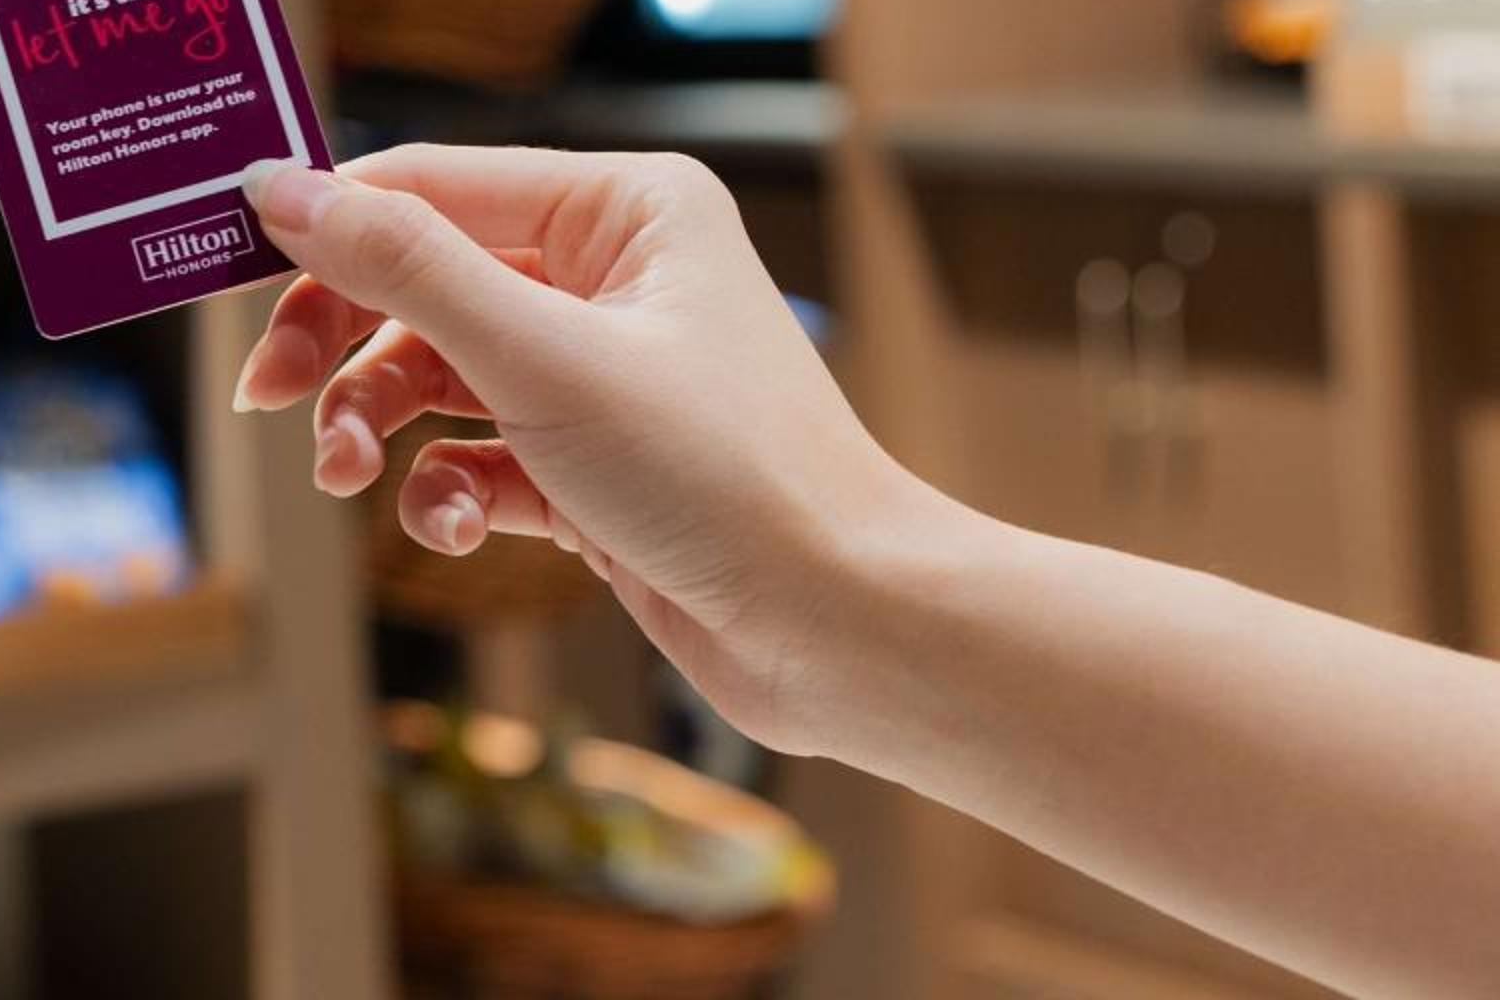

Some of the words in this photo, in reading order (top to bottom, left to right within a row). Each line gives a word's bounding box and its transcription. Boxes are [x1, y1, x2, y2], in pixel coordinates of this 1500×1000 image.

[11, 3, 80, 70] let
[89, 2, 176, 48] me
[46, 117, 88, 135] Your
[90, 100, 145, 127] phone
[147, 95, 163, 108] is
[164, 84, 201, 103] now
[204, 72, 243, 95] your
[51, 133, 99, 156] room
[99, 125, 136, 142] key.
[137, 98, 225, 131] Download
[225, 89, 256, 106] the
[57, 151, 114, 175] Hilton
[114, 132, 179, 159] Honors
[180, 122, 219, 141] app.
[143, 226, 241, 268] Hilton
[165, 251, 232, 278] HONORS
